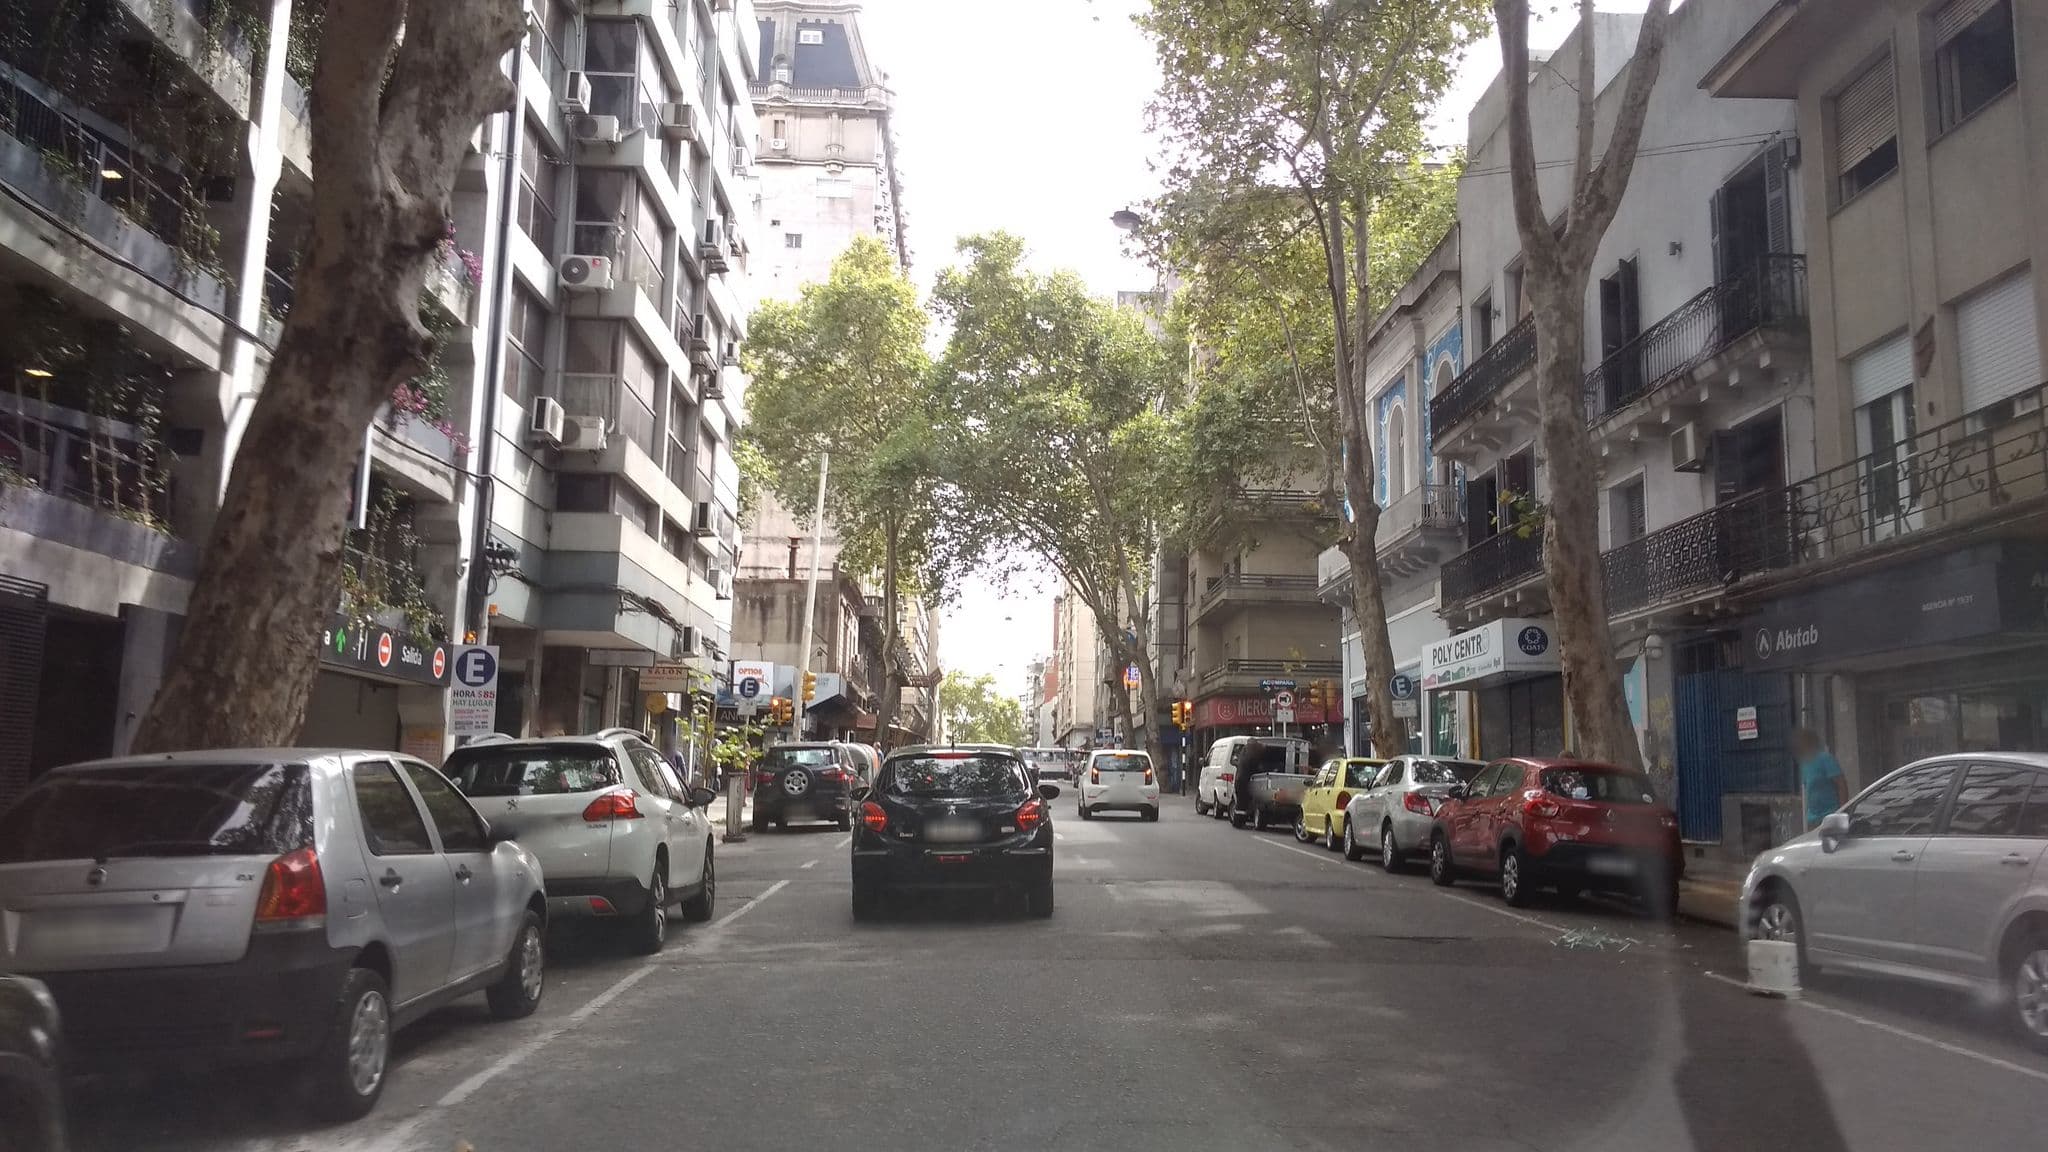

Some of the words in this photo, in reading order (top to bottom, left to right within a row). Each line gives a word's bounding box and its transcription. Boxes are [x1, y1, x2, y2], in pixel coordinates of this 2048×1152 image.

[1775, 624, 1818, 651] Abitab
[402, 645, 422, 666] Salida
[1432, 644, 1451, 667] POLY
[465, 652, 486, 683] E
[453, 690, 475, 698] HORA
[745, 679, 756, 697] E
[1395, 678, 1408, 697] E
[468, 700, 494, 708] LUGAR
